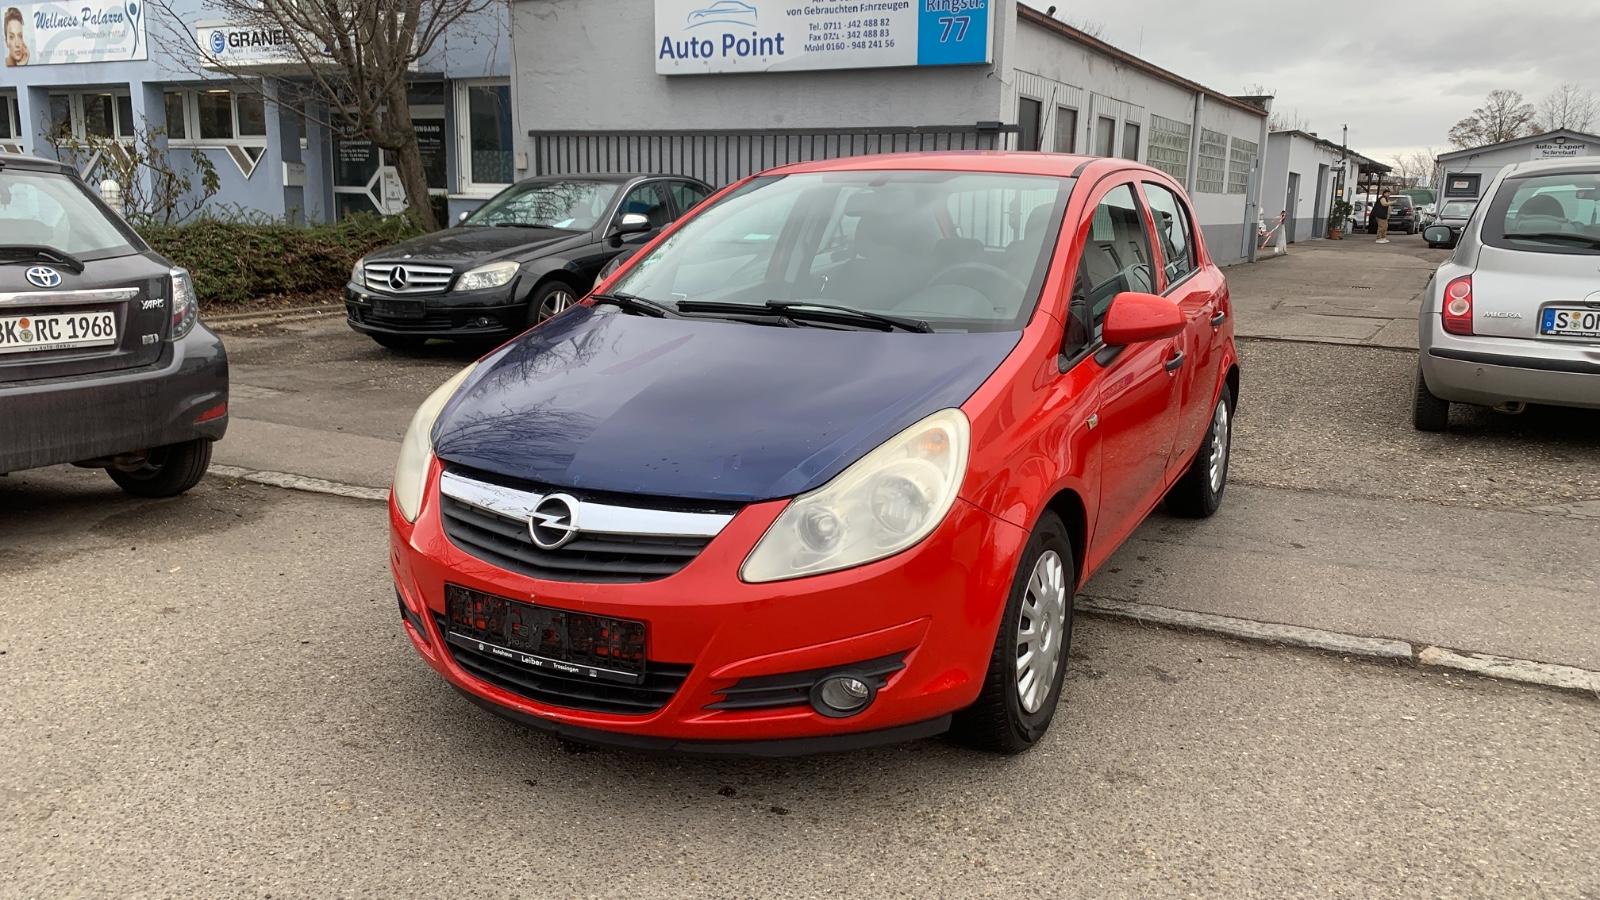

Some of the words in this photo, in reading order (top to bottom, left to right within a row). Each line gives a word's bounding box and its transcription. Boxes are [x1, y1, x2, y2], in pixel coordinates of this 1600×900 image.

[787, 8, 802, 16] von
[804, 4, 858, 15] Gebrauchten
[860, 1, 909, 12] Fahrzeugen
[33, 11, 78, 30] Wellness
[81, 6, 123, 27] Palazzo
[809, 23, 822, 31] Tel.
[823, 22, 842, 31] 0711
[847, 20, 861, 28] 342
[863, 18, 878, 27] 488
[880, 18, 890, 26] 82
[809, 33, 821, 41] Fax
[847, 30, 861, 39] 342
[863, 29, 878, 38] 488
[880, 29, 890, 37] 83
[938, 16, 971, 43] 77
[659, 36, 714, 60] Auto
[722, 31, 785, 57] Point
[826, 42, 845, 51] 0160
[851, 41, 866, 50] 948
[868, 40, 882, 49] 241
[884, 39, 895, 48] 56
[141, 298, 165, 310] YARIS
[1483, 311, 1522, 319] MICRA
[1556, 312, 1569, 329] S
[34, 317, 61, 341] RC
[66, 315, 114, 339] 1968
[492, 647, 513, 658] Autohaus
[521, 655, 543, 667] Leiber
[553, 662, 580, 673] Trossingen
